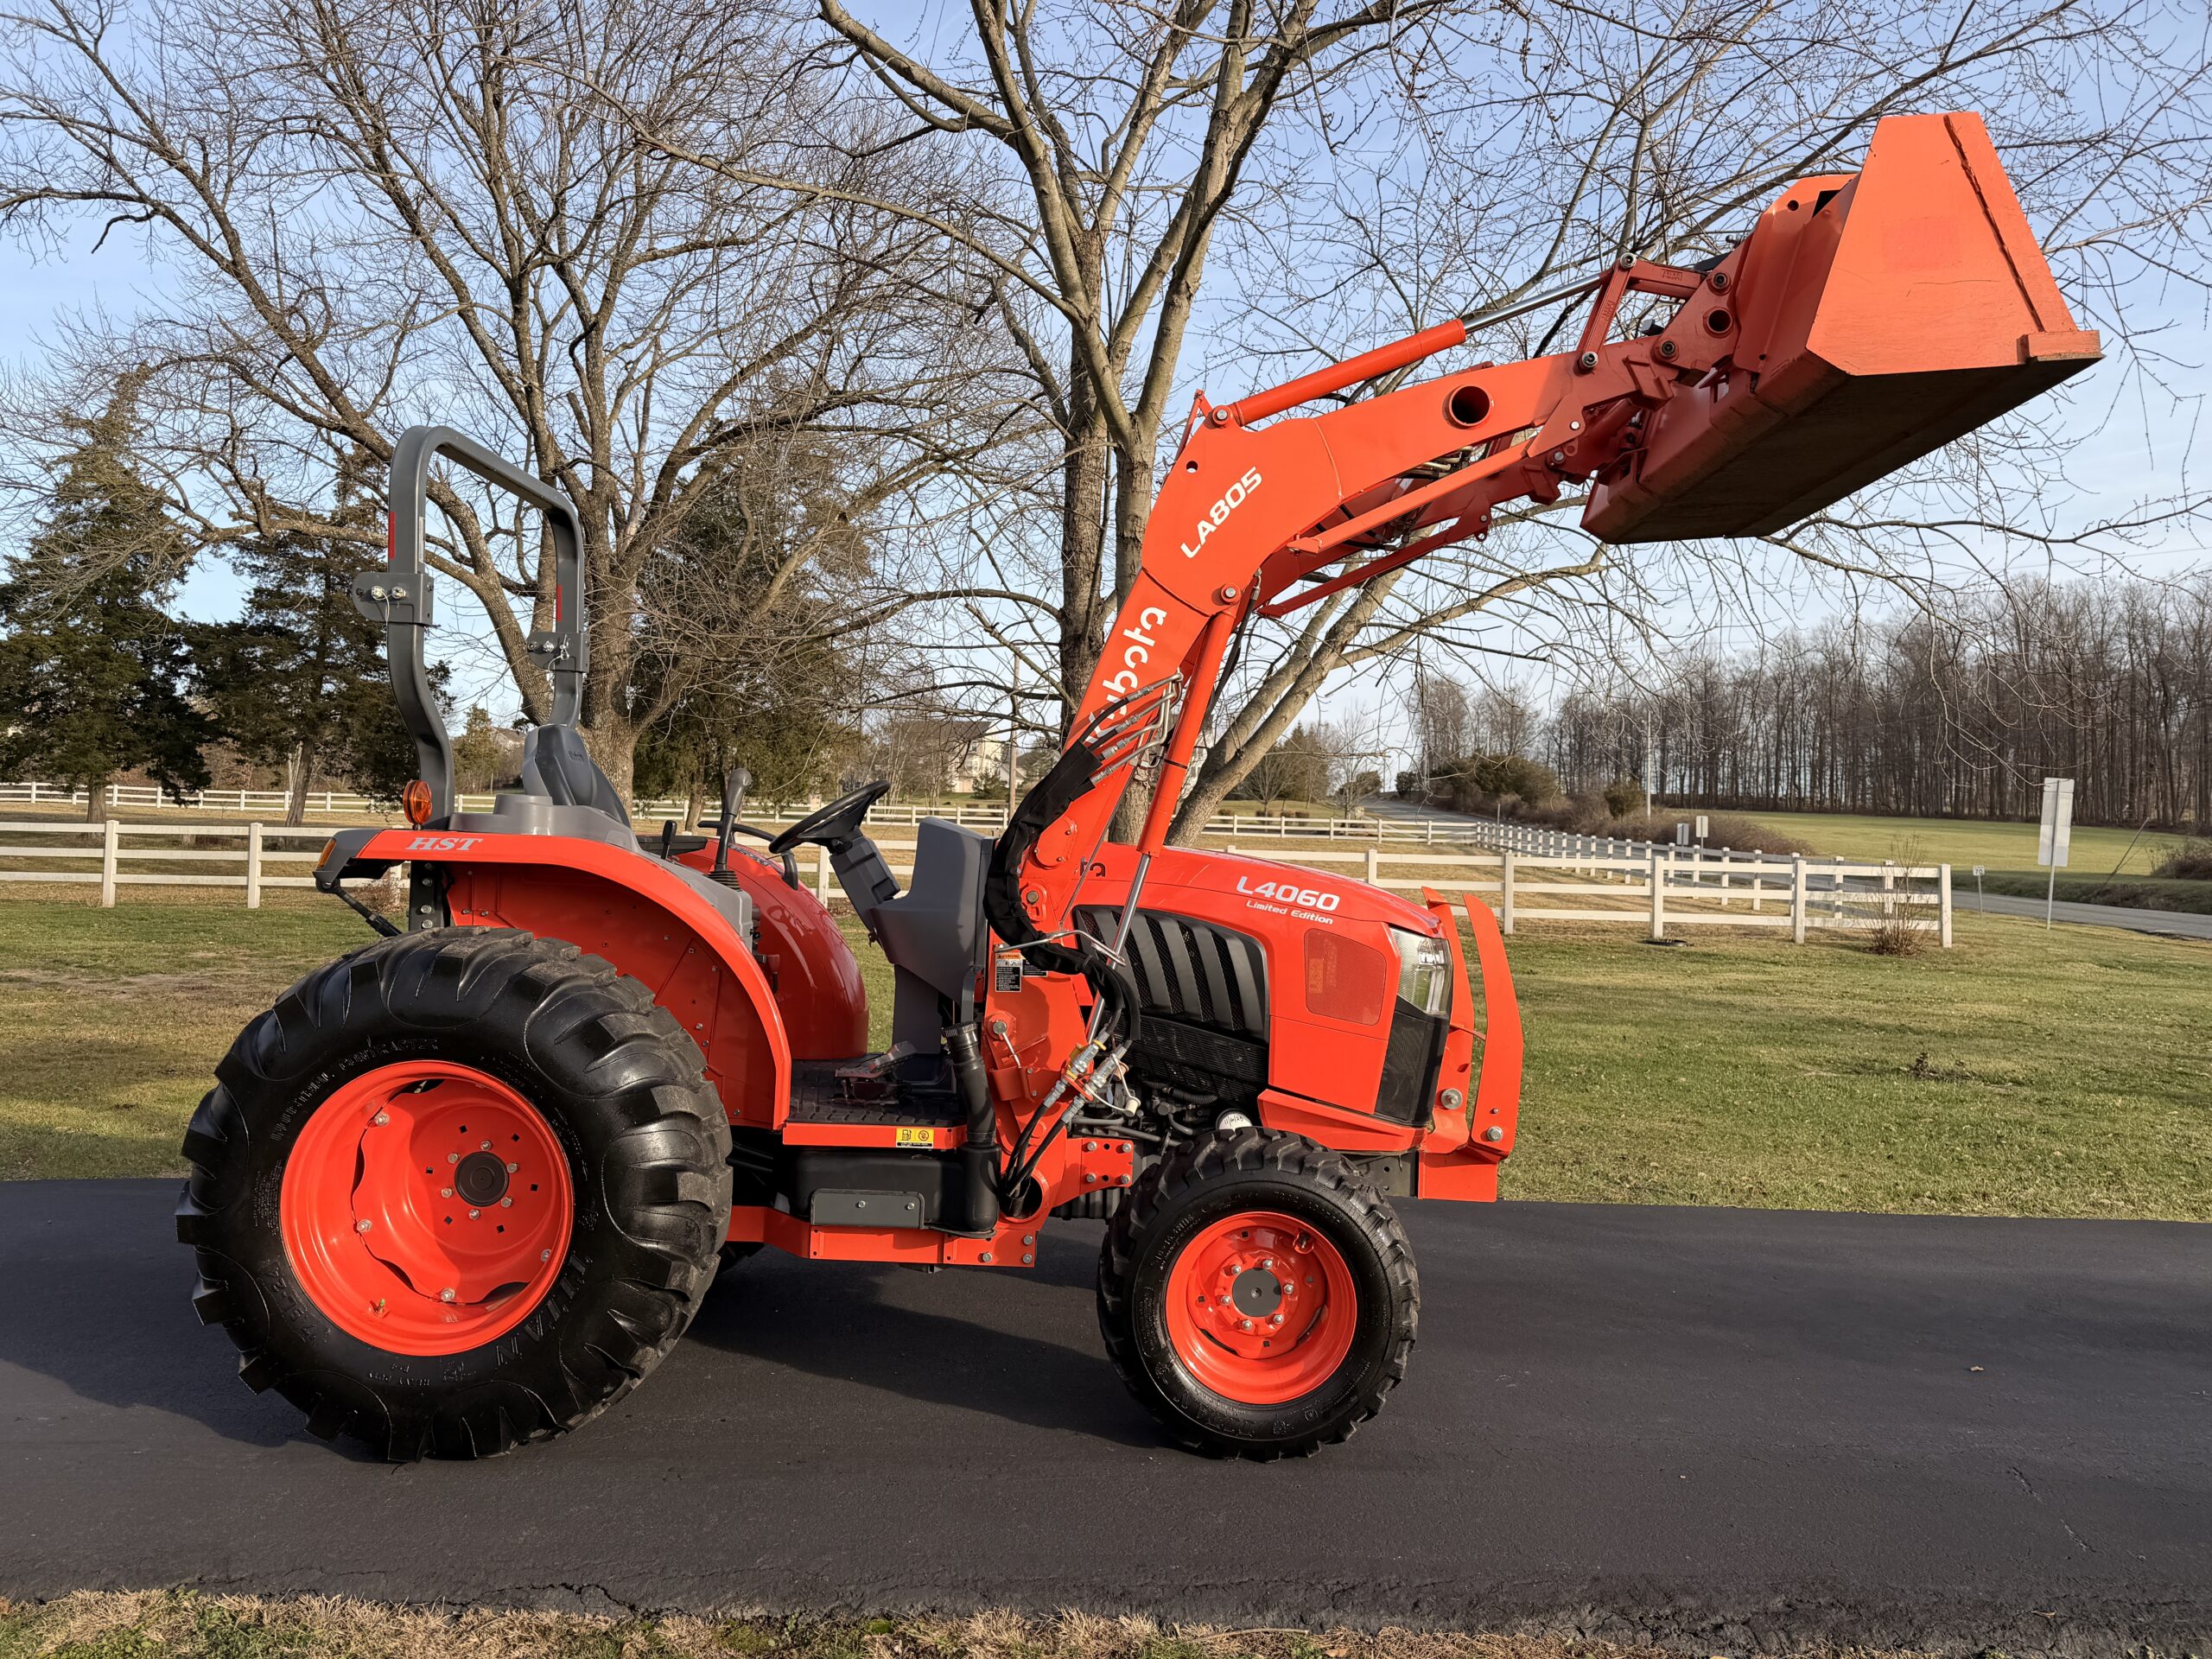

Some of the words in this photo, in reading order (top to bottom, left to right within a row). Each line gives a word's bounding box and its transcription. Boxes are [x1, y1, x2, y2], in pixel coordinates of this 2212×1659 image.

[1180, 467, 1262, 558] LA805
[404, 837, 484, 851] HST
[1236, 876, 1340, 912] L4060
[1246, 900, 1287, 914] Limited
[1291, 910, 1334, 925] Edition
